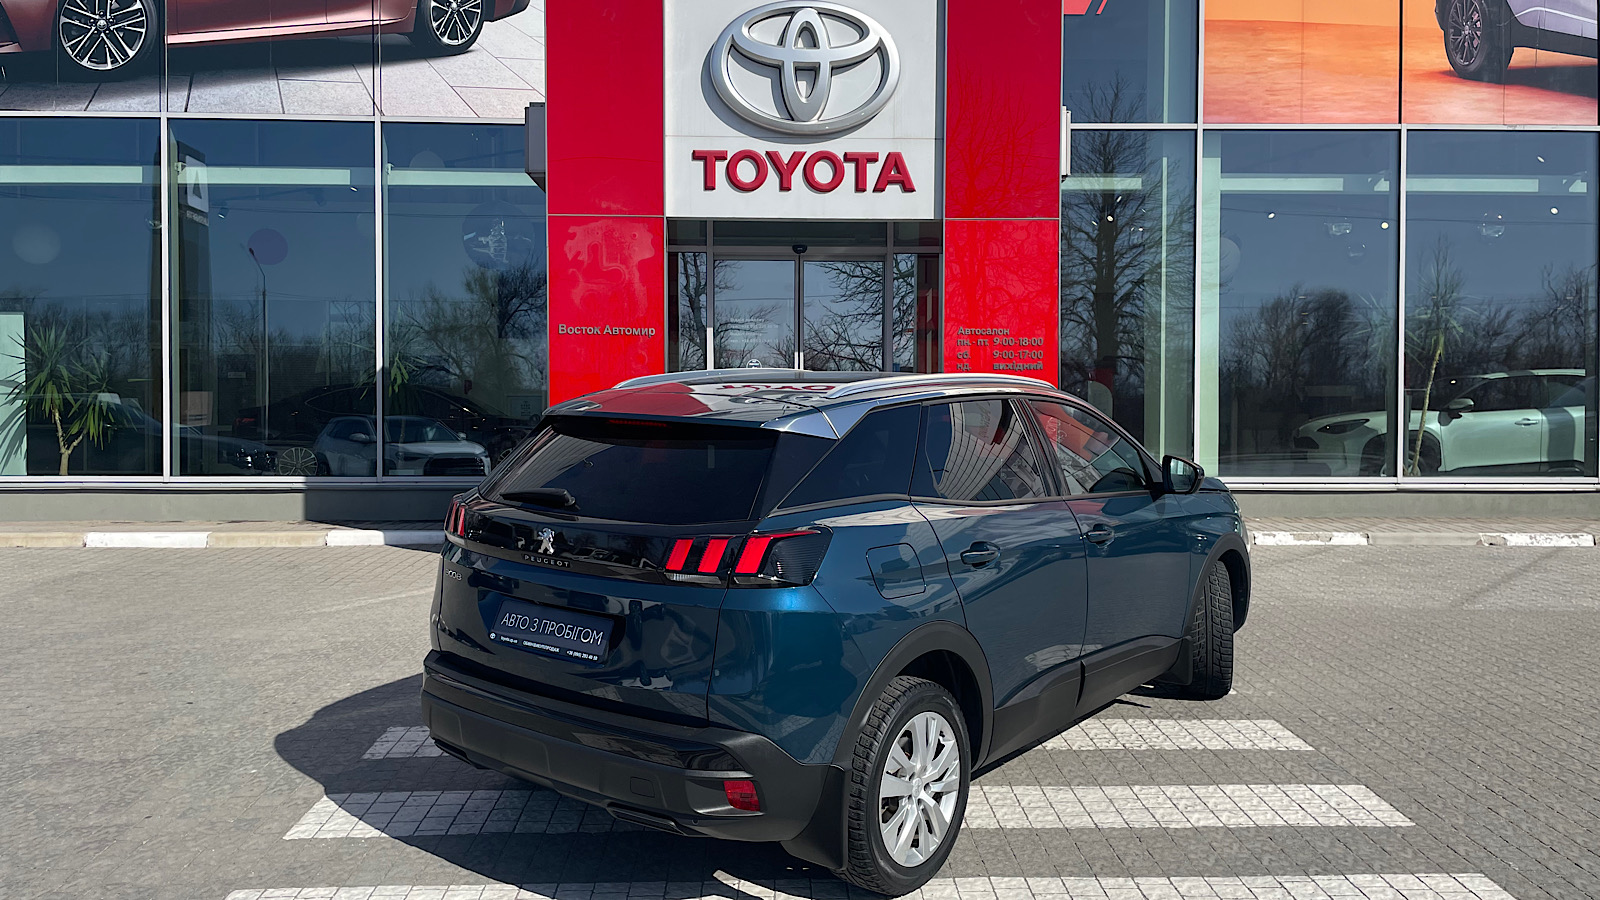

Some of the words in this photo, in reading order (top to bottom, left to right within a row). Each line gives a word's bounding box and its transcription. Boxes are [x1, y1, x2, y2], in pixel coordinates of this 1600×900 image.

[691, 149, 916, 193] TOYOTA
[558, 324, 601, 335] Восток
[603, 325, 656, 338] Автомир
[957, 327, 1010, 335] Автосалон
[993, 337, 1044, 346] 9:00-18:00
[957, 350, 971, 359] сб.
[993, 350, 1044, 359] 9:00-17:00
[957, 362, 971, 371] нд.
[993, 361, 1044, 372] вихідний
[524, 554, 569, 567] PEUGEOT
[500, 612, 530, 630] АВТО
[539, 619, 604, 646] ПРОБІГОМ
